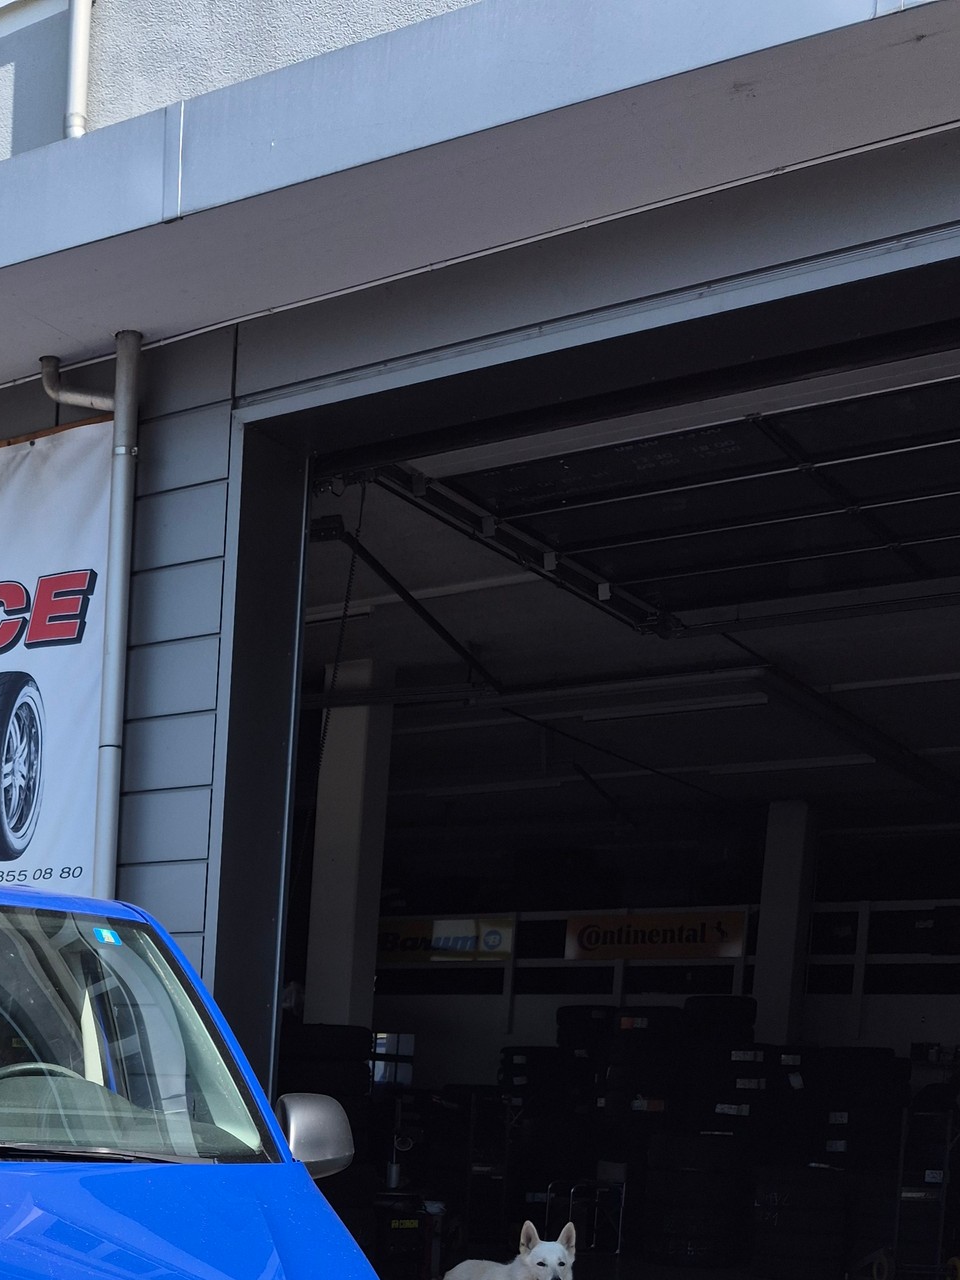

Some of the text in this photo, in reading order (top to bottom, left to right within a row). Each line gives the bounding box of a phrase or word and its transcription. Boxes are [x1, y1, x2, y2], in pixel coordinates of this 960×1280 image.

[32, 867, 53, 881] 08
[59, 866, 83, 879] 80
[577, 921, 707, 951] Continental
